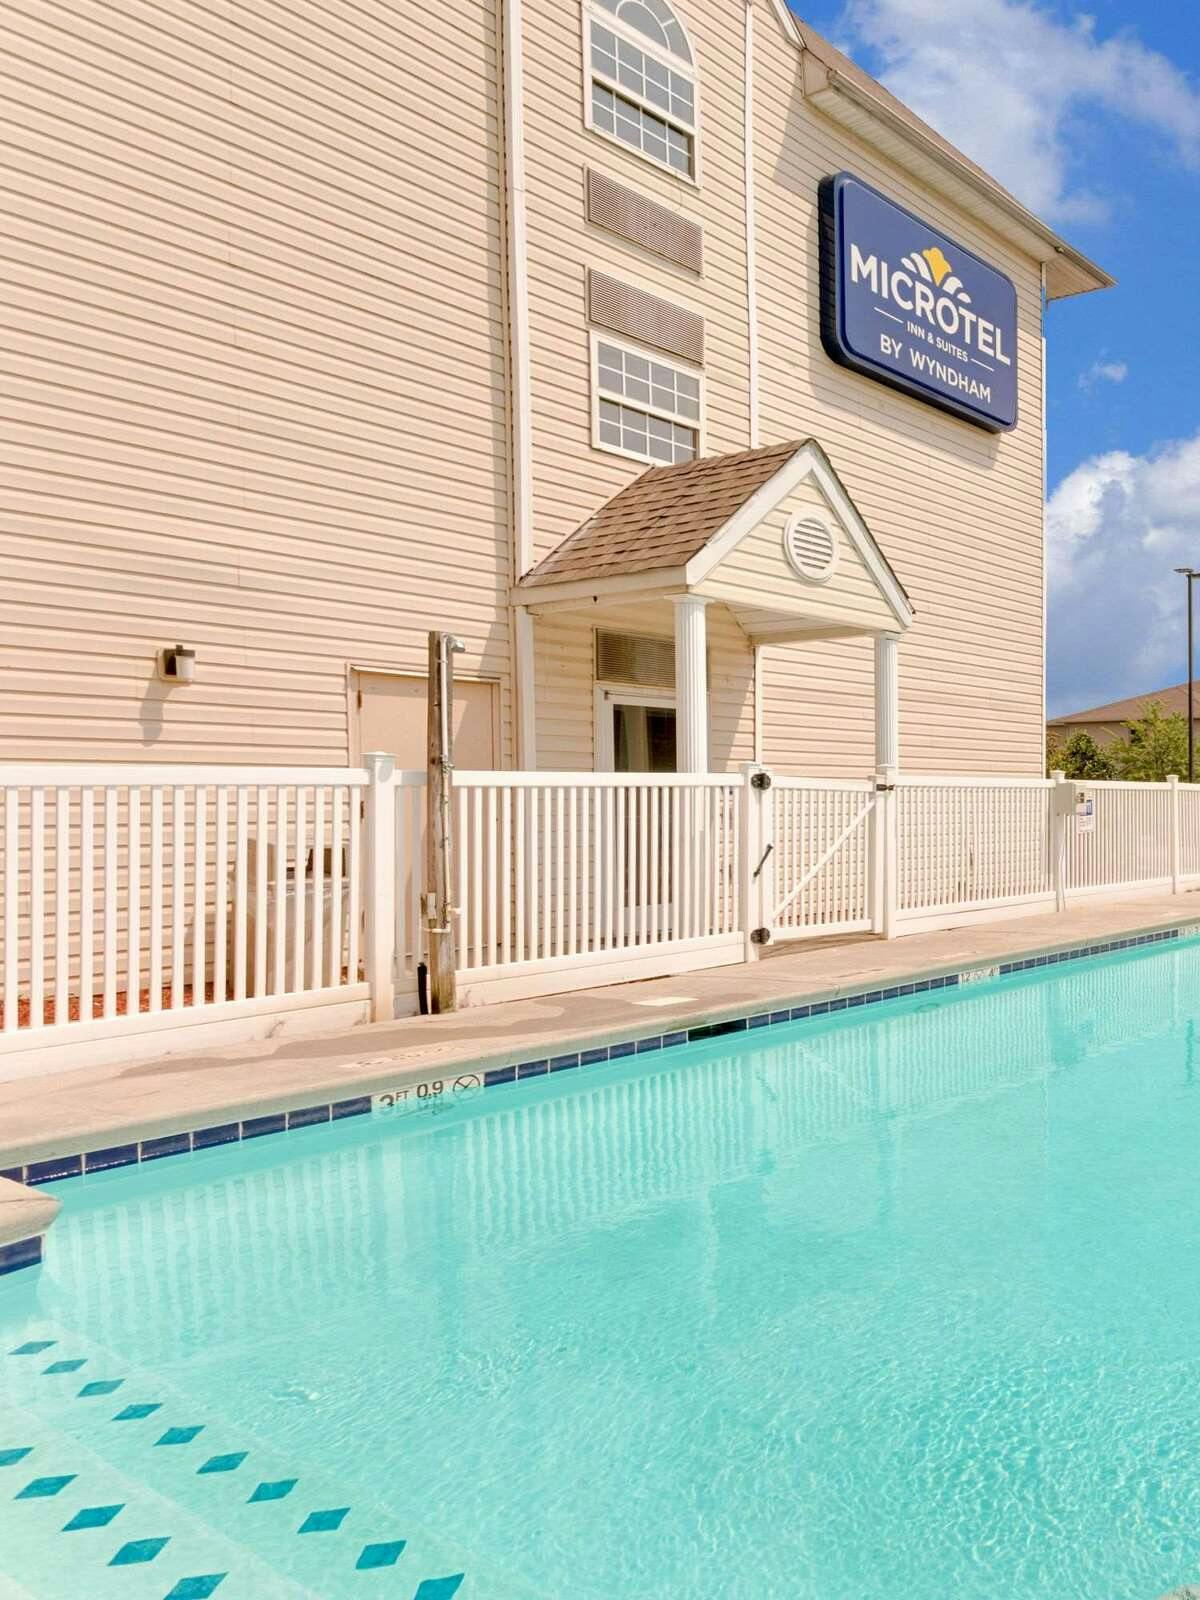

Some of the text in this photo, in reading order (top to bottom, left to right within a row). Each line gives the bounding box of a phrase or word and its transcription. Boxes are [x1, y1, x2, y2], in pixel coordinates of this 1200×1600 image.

[850, 244, 1011, 366] MICROTEL
[880, 333, 992, 404] BY WYNDHAM
[907, 321, 969, 362] INN & SUITES
